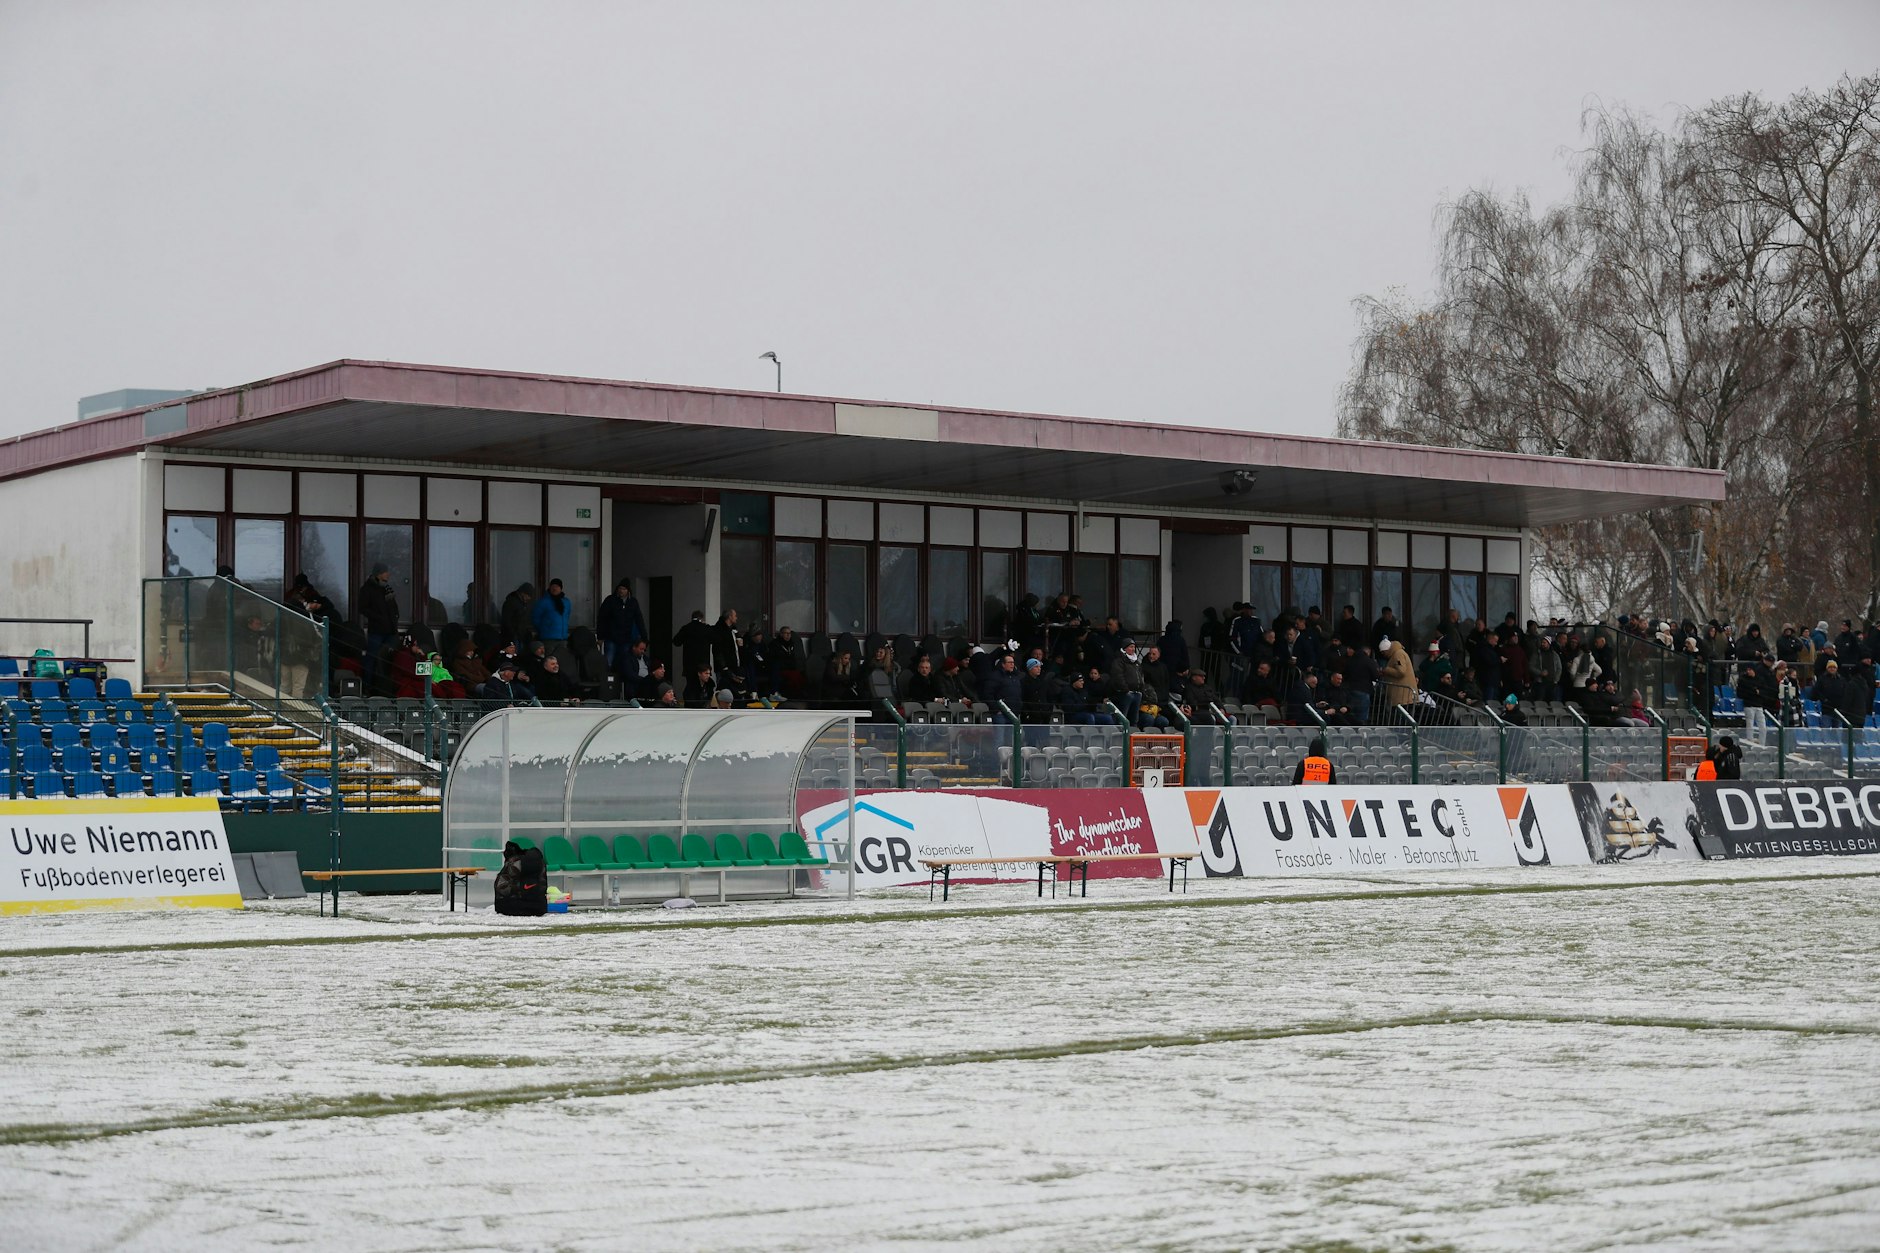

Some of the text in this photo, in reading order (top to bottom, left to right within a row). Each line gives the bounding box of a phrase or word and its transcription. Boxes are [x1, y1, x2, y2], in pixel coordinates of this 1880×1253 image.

[1054, 807, 1142, 846] Ihr dynamischer
[1262, 798, 1456, 842] UNITEC
[1453, 798, 1471, 838] GmbH
[10, 825, 219, 855] Uwe Niemann
[918, 844, 975, 858] Köpenicker
[1275, 844, 1480, 868] Fassade Maler Betonschutz
[20, 863, 226, 891] Fußbodenverlegerei
